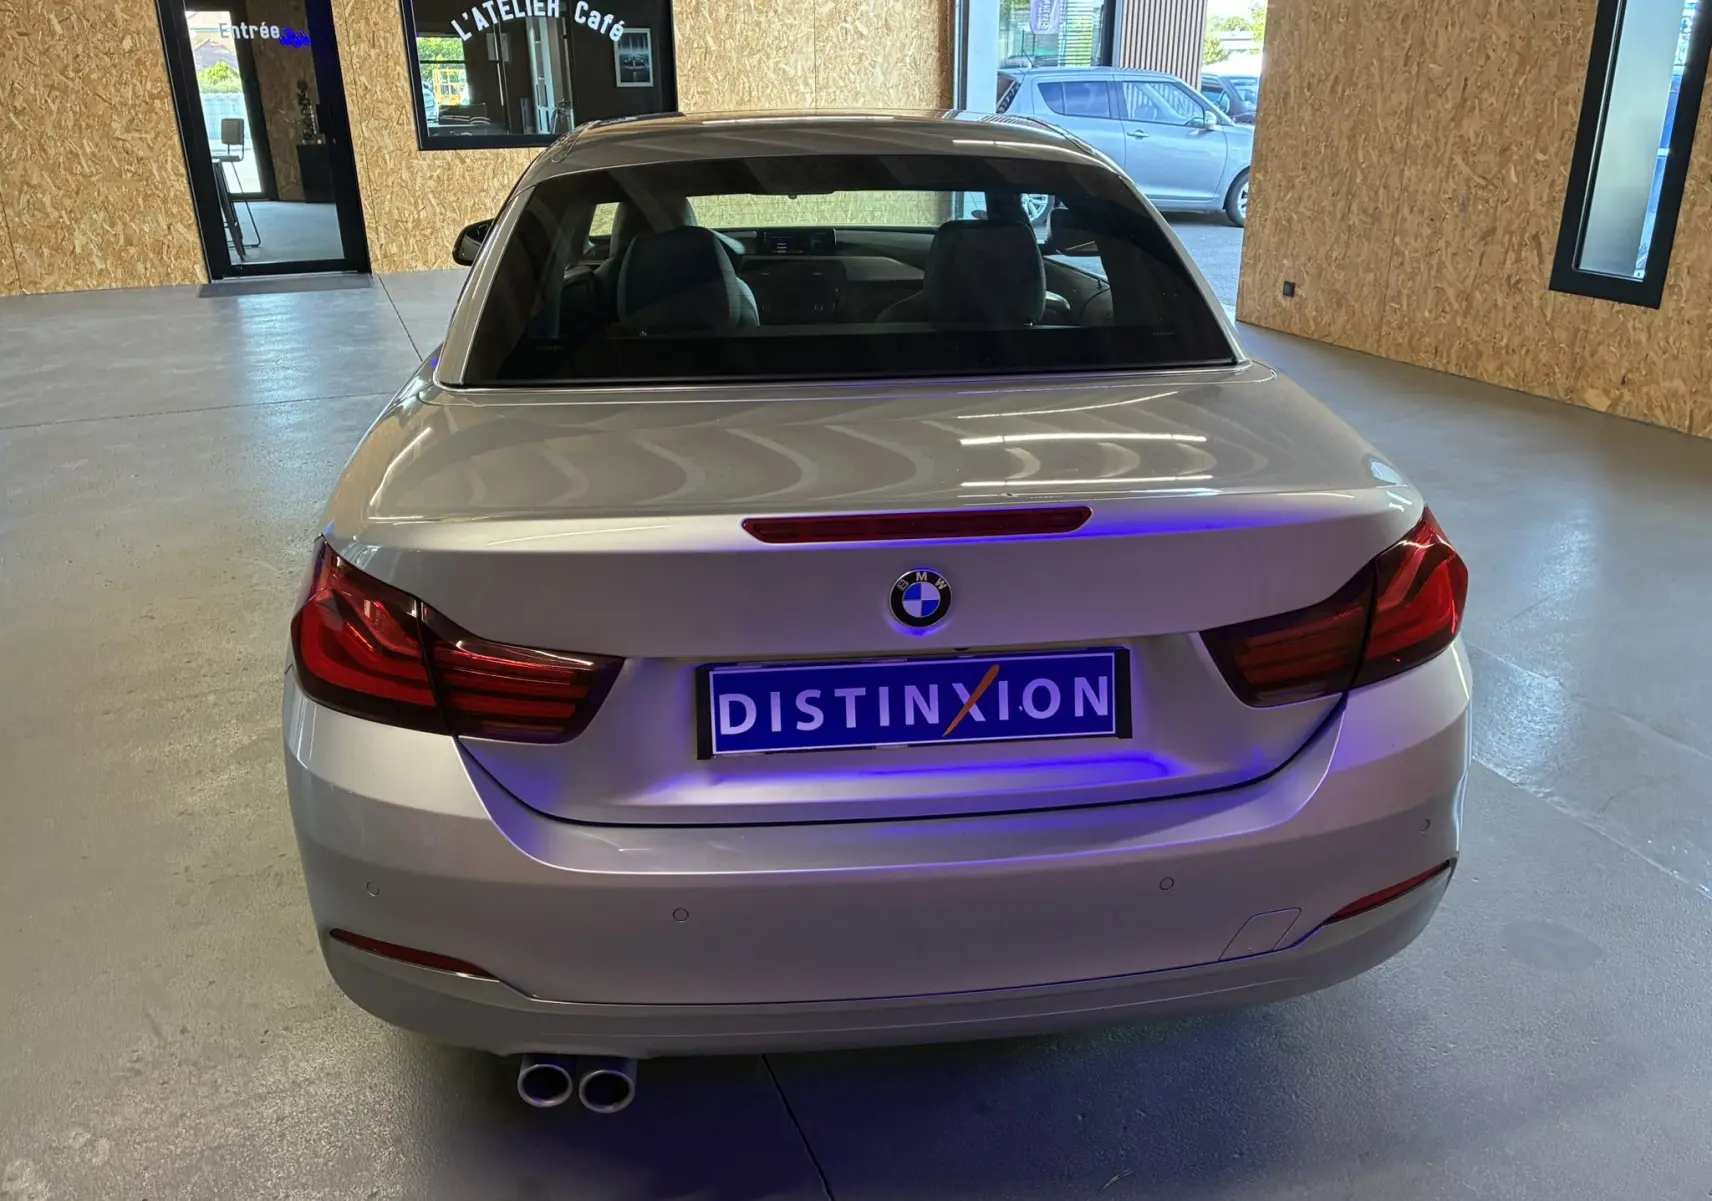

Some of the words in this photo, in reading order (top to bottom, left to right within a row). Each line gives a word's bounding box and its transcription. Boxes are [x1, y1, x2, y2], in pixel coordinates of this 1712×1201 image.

[219, 22, 281, 39] Entrée
[451, 0, 560, 41] L'ATELIER
[574, 1, 626, 42] Café
[896, 571, 948, 591] BMW
[719, 664, 1109, 738] DISTINXION
